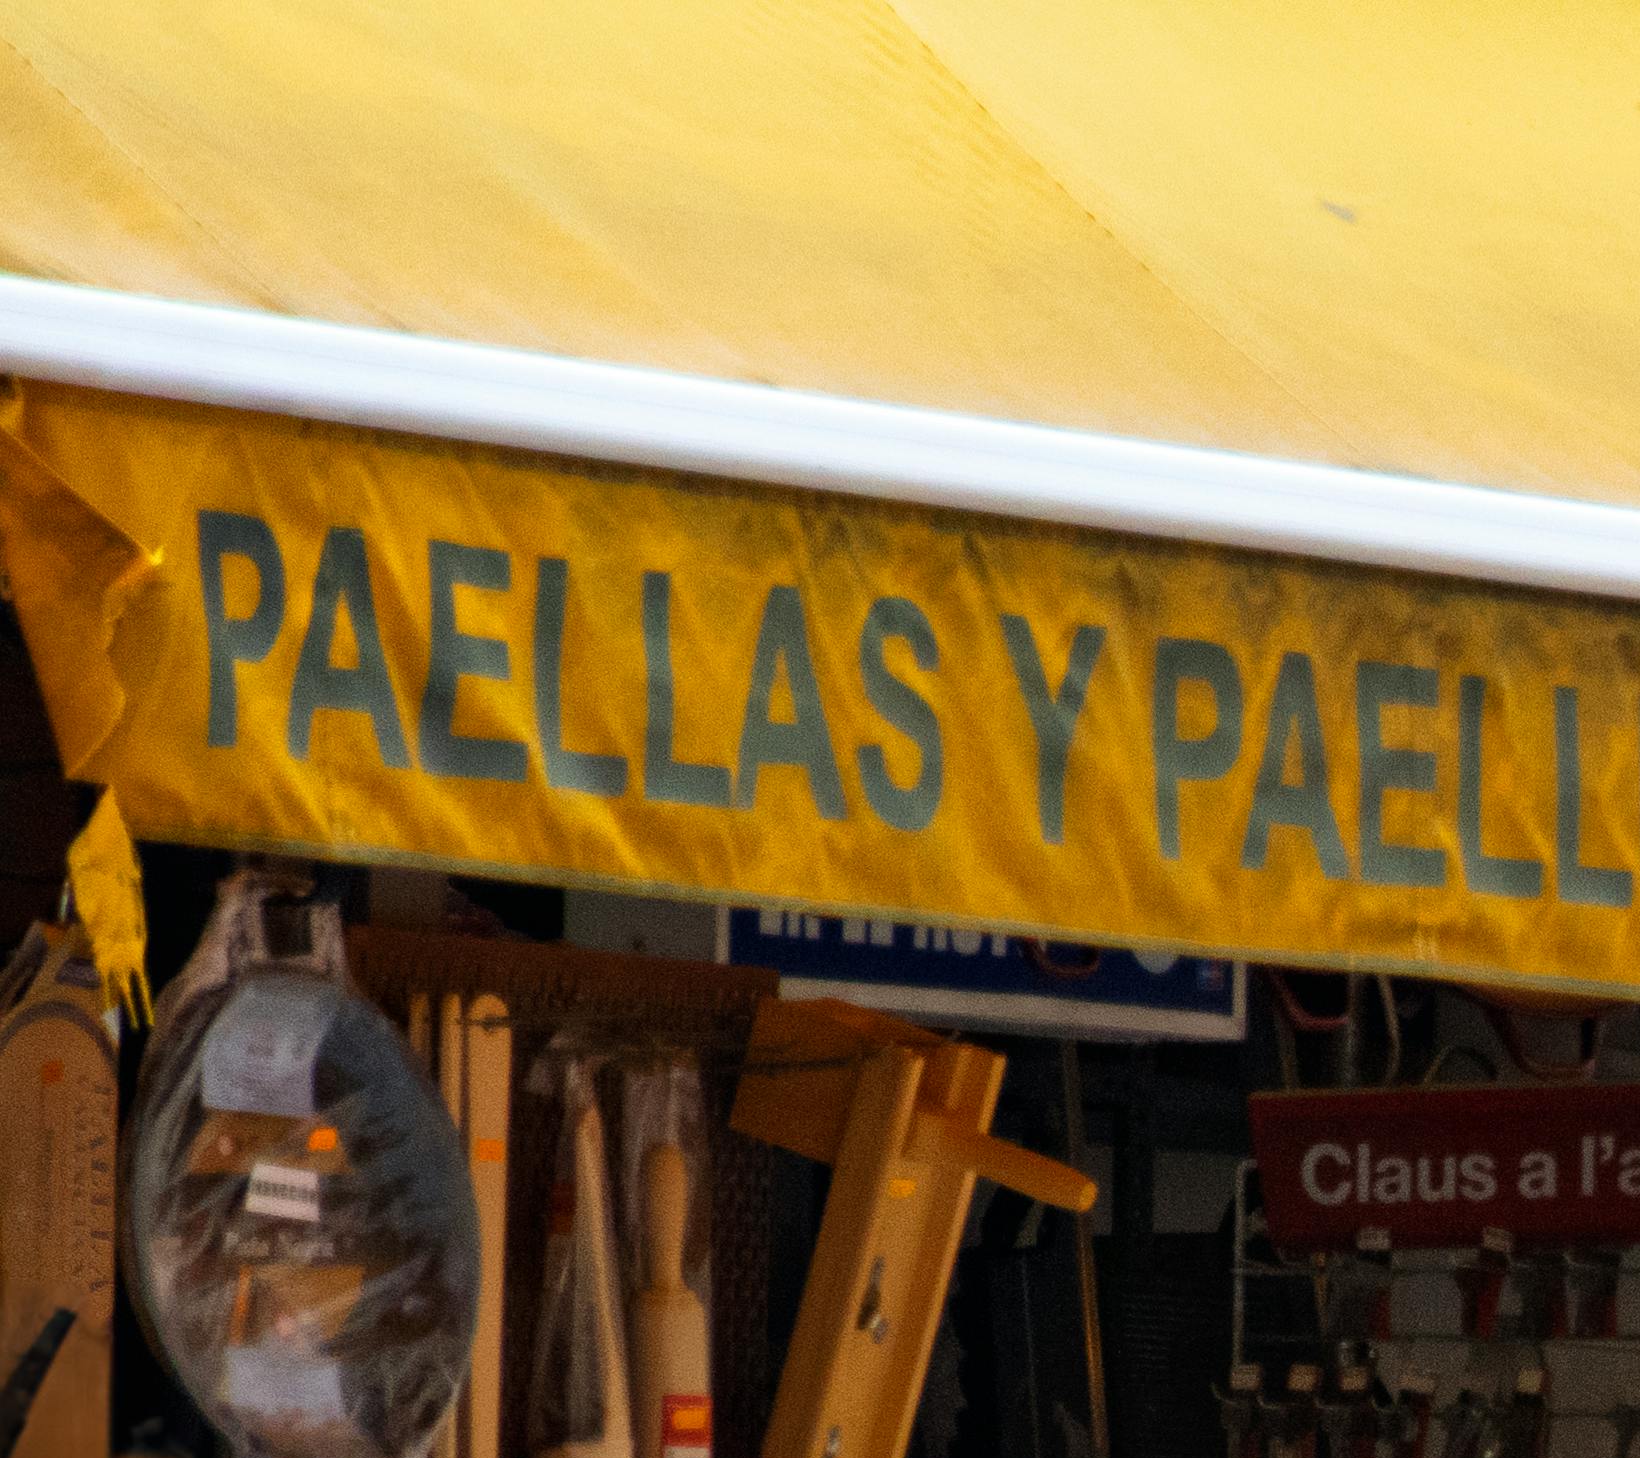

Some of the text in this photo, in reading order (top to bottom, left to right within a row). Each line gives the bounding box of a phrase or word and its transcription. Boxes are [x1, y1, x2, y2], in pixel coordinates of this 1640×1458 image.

[198, 510, 944, 833] PAELLAS
[1001, 615, 1106, 844] Y
[1300, 1142, 1496, 1206] Claus
[1517, 1152, 1559, 1199] a
